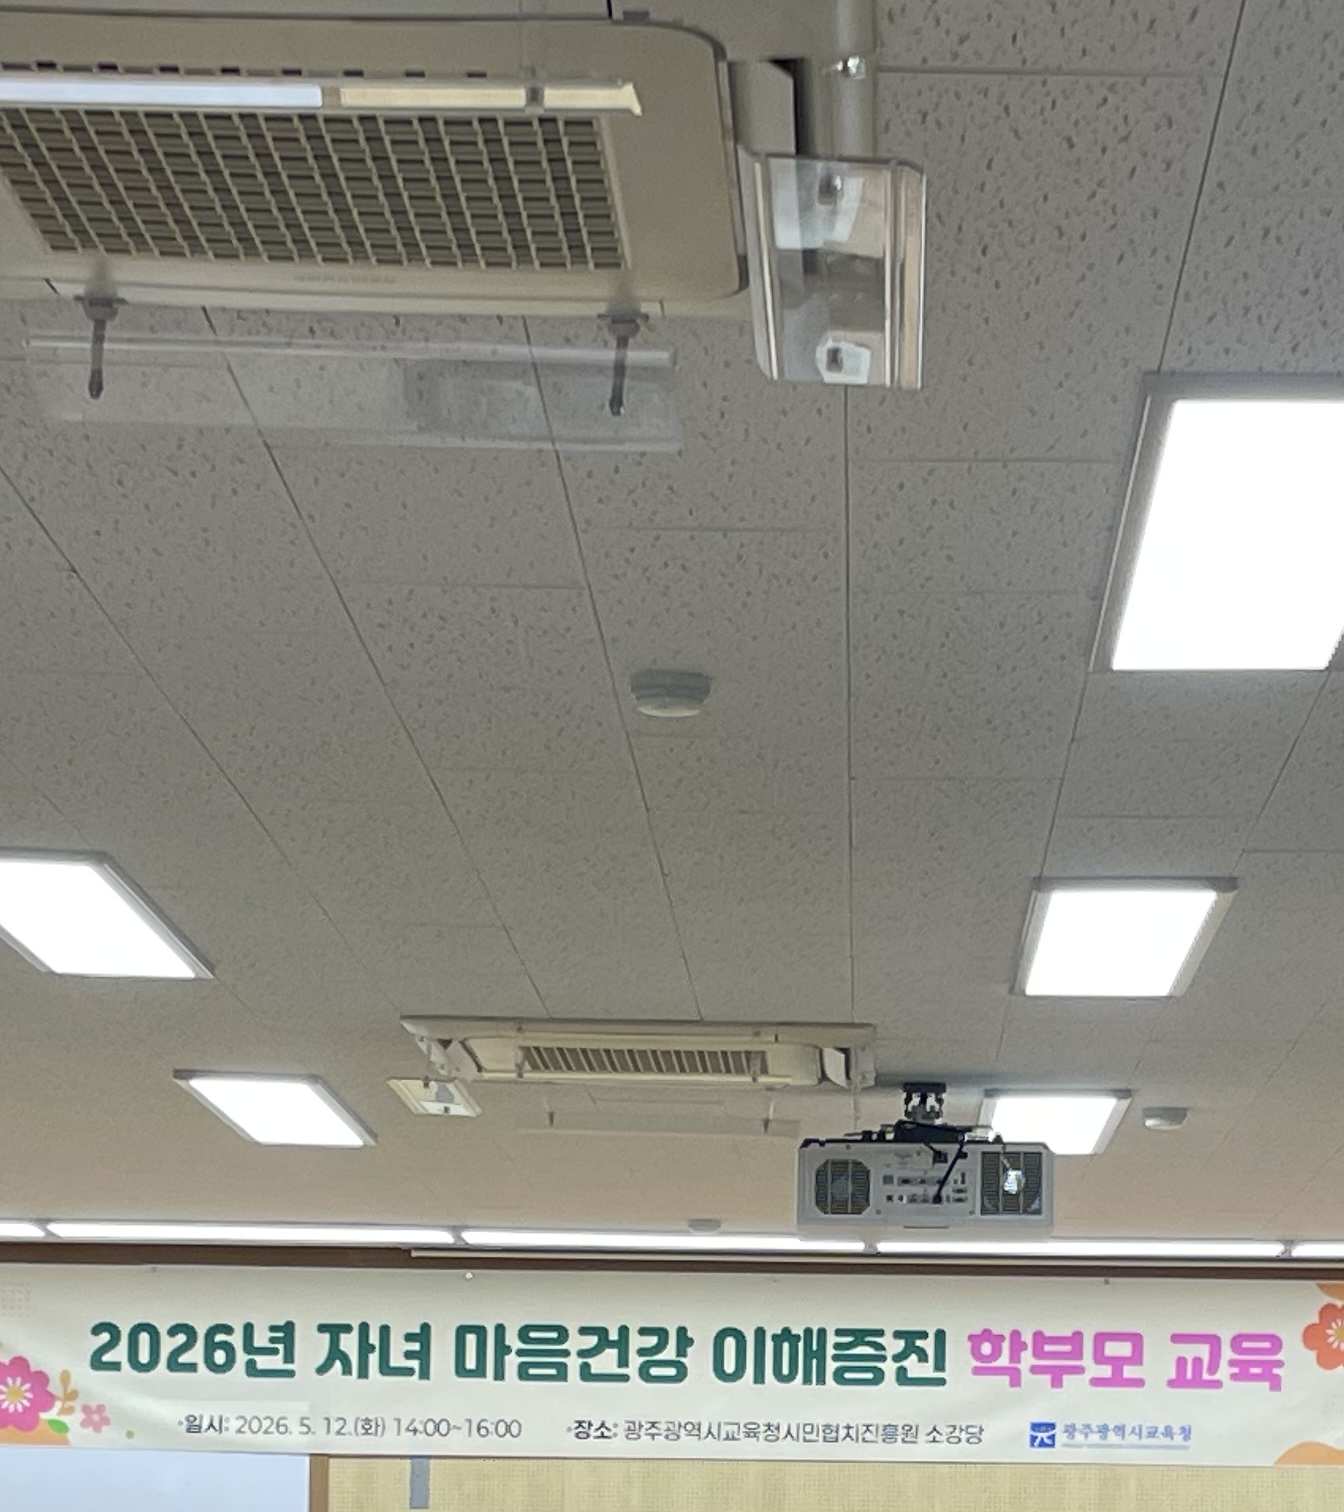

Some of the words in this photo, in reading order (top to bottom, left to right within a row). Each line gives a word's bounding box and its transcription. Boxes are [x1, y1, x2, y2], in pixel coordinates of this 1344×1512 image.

[89, 1320, 296, 1380] 2026년
[315, 1321, 433, 1381] 자녀
[455, 1323, 694, 1384] 마음건강
[711, 1326, 948, 1387] 이해증진
[967, 1329, 1145, 1389] 학부모
[1166, 1332, 1284, 1391] 교육
[184, 1413, 230, 1435] 일시:
[234, 1415, 293, 1436] 2026.
[299, 1416, 316, 1436] 5.
[394, 1417, 523, 1439] 14:00~16:00
[573, 1419, 619, 1441] 장소:
[623, 1420, 920, 1445] 광주광역시교육청시민협치진흥원
[924, 1424, 985, 1446] 소강당
[1061, 1422, 1192, 1443] 광주광역시교육청
